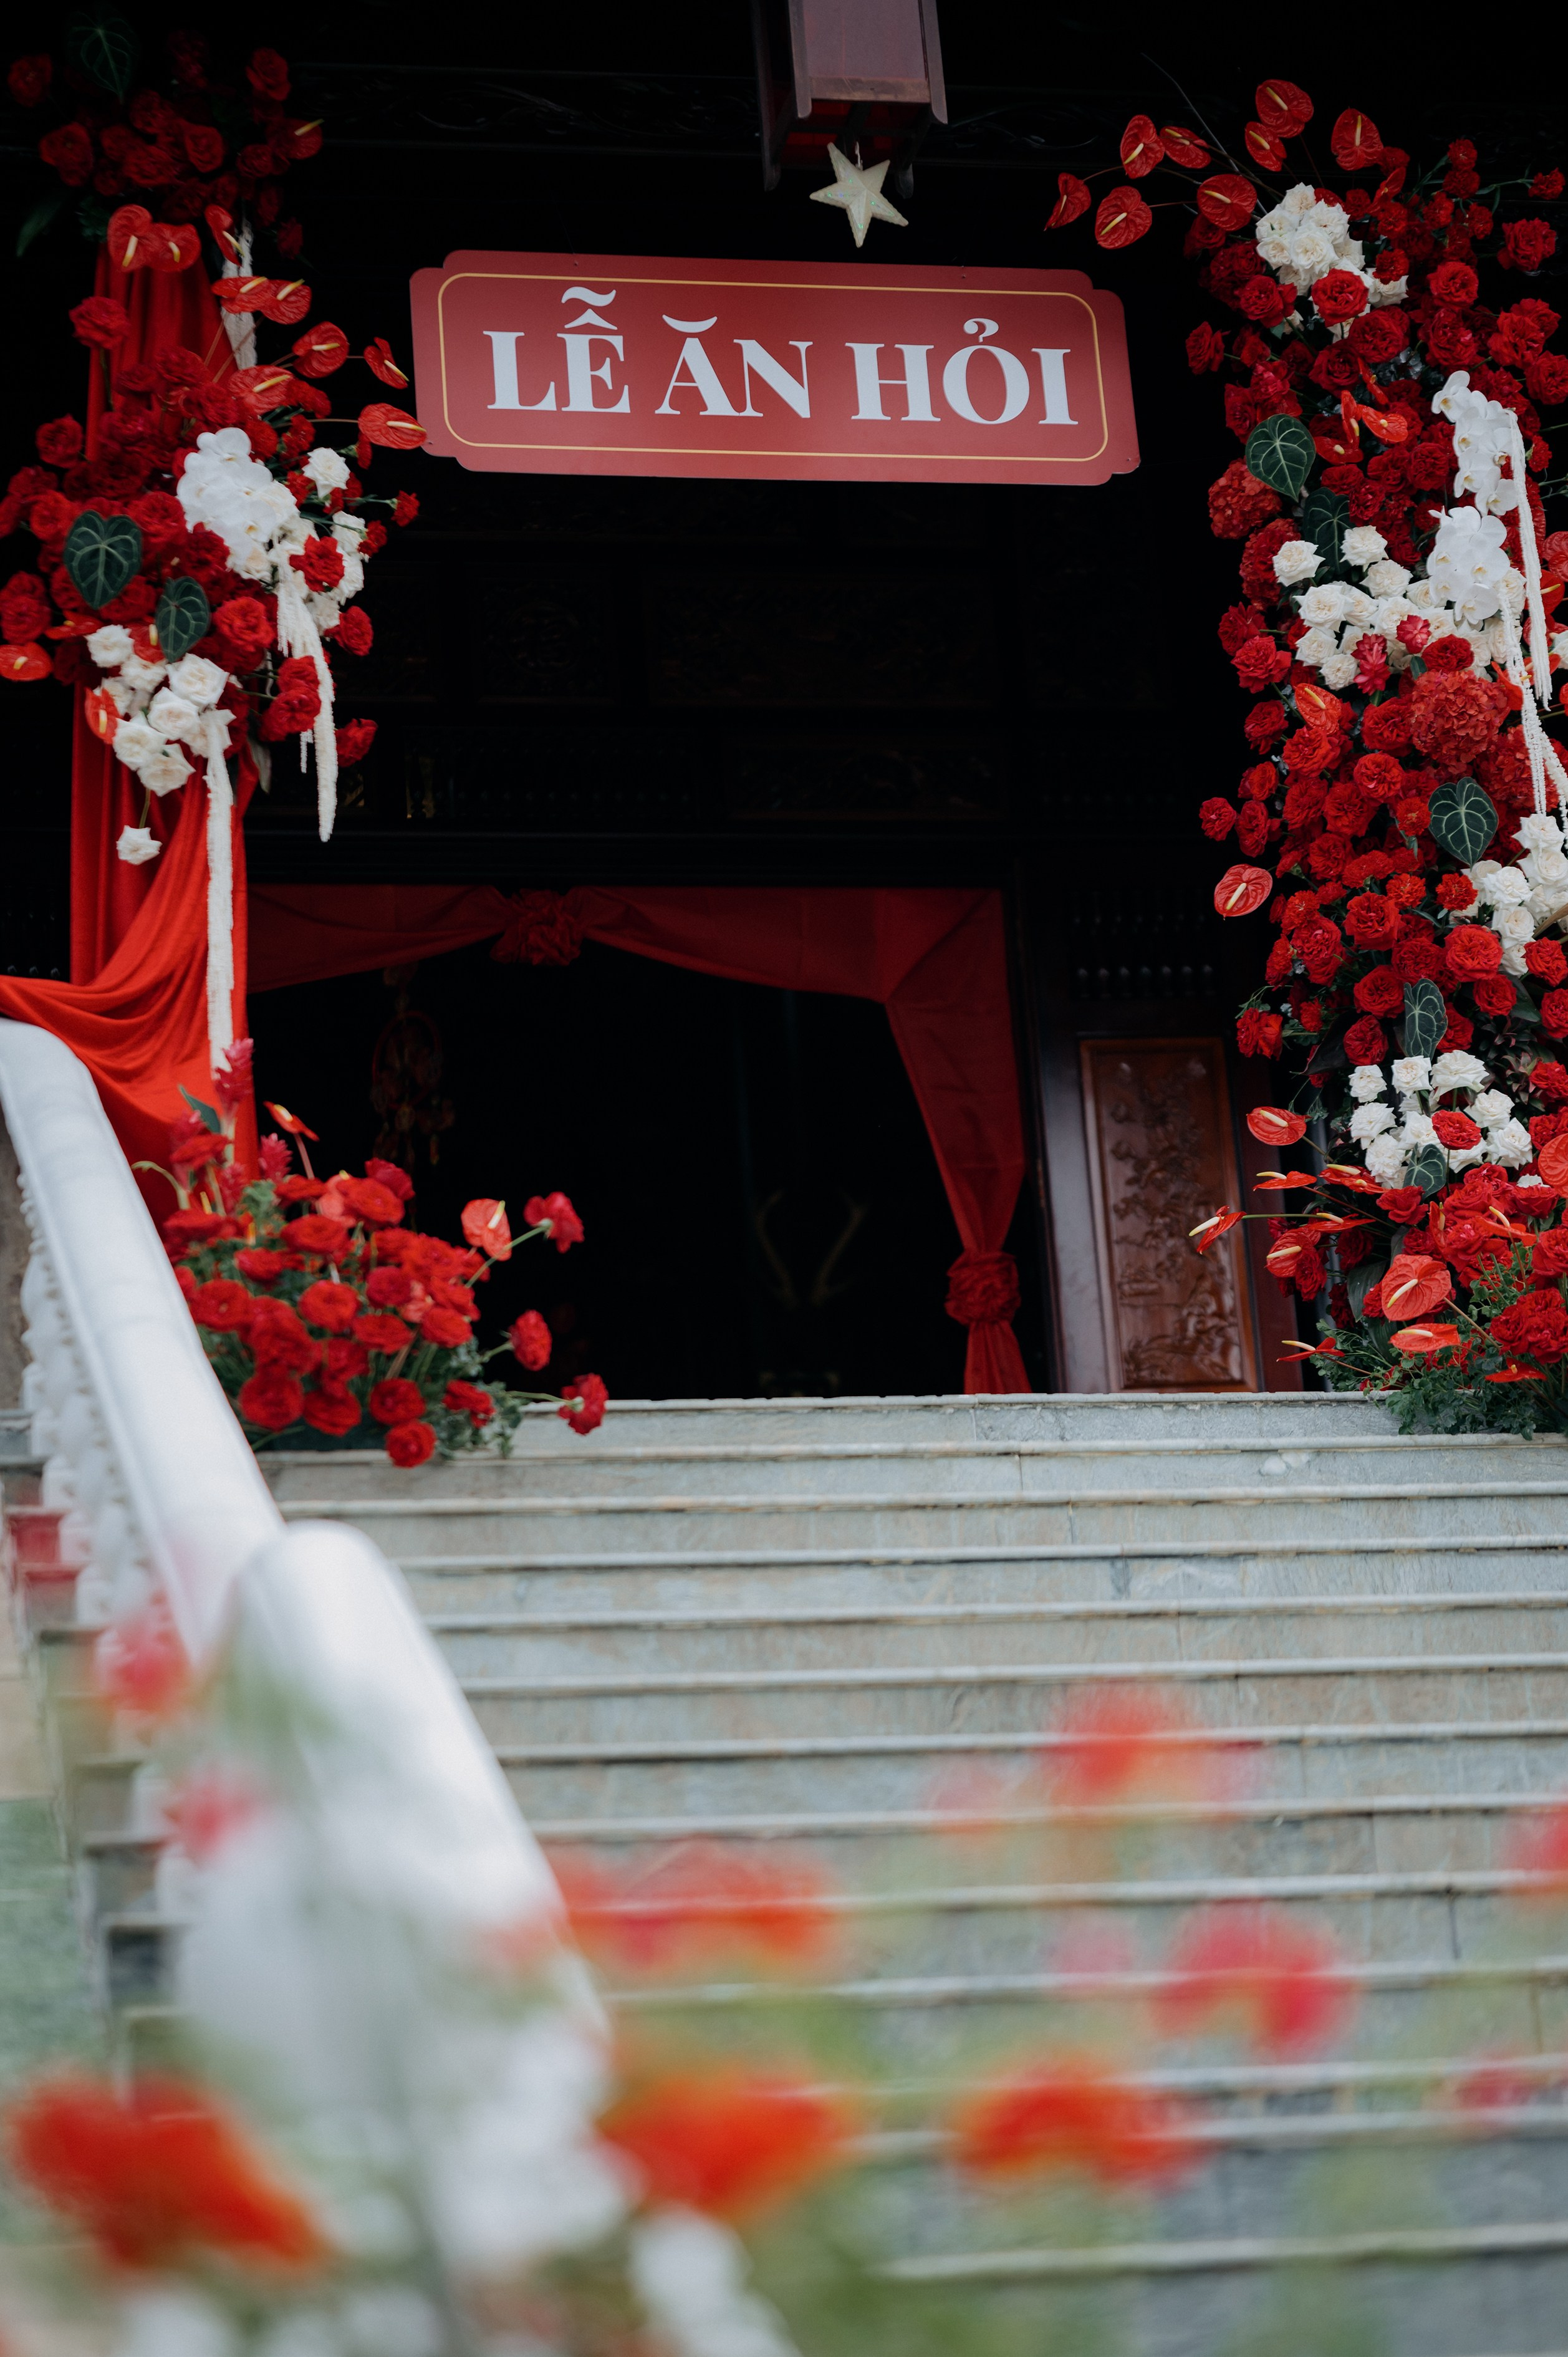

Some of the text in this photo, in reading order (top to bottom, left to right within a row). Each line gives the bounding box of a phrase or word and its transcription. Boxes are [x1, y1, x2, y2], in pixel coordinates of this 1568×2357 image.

[483, 287, 1079, 425] LỄ ĂN HỎI
